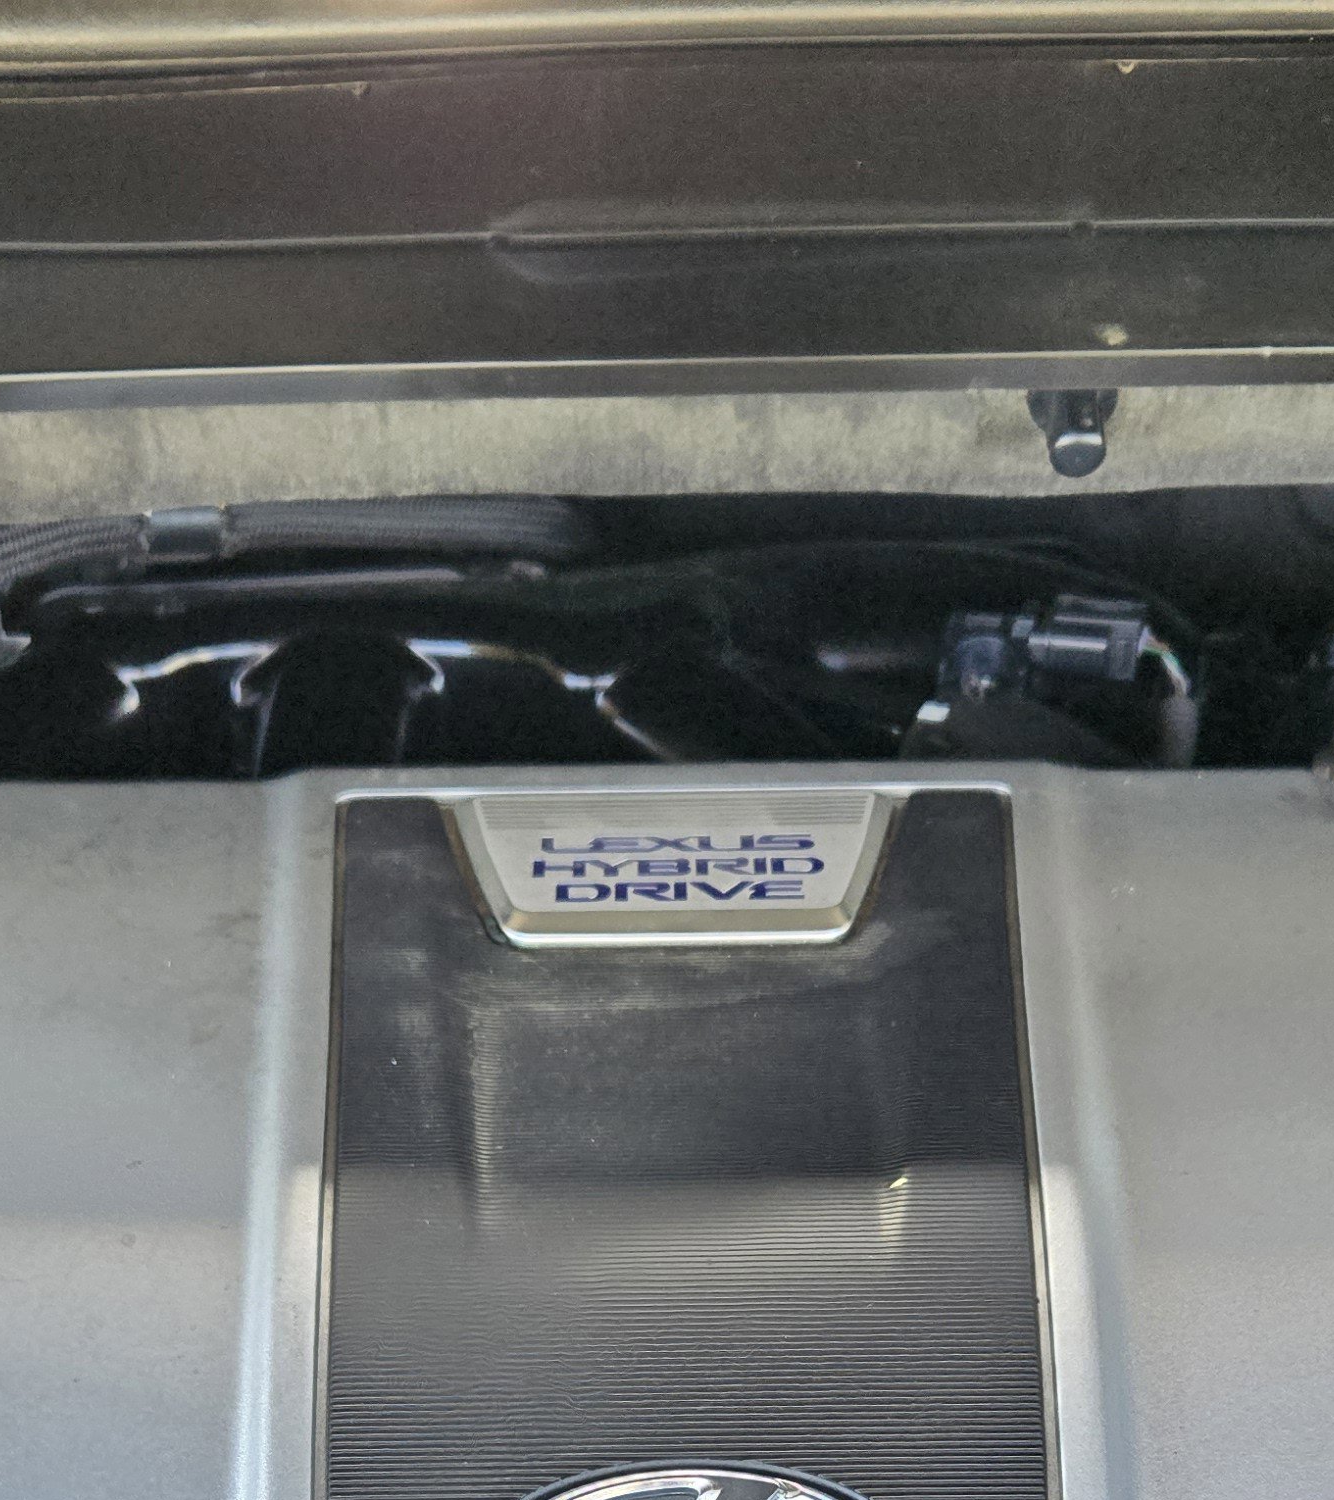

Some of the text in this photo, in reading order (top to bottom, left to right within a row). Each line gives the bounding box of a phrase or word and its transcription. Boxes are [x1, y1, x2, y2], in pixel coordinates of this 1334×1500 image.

[541, 834, 816, 853] LEXUS
[532, 857, 825, 878] HYBRID
[555, 880, 806, 902] DRIVE
